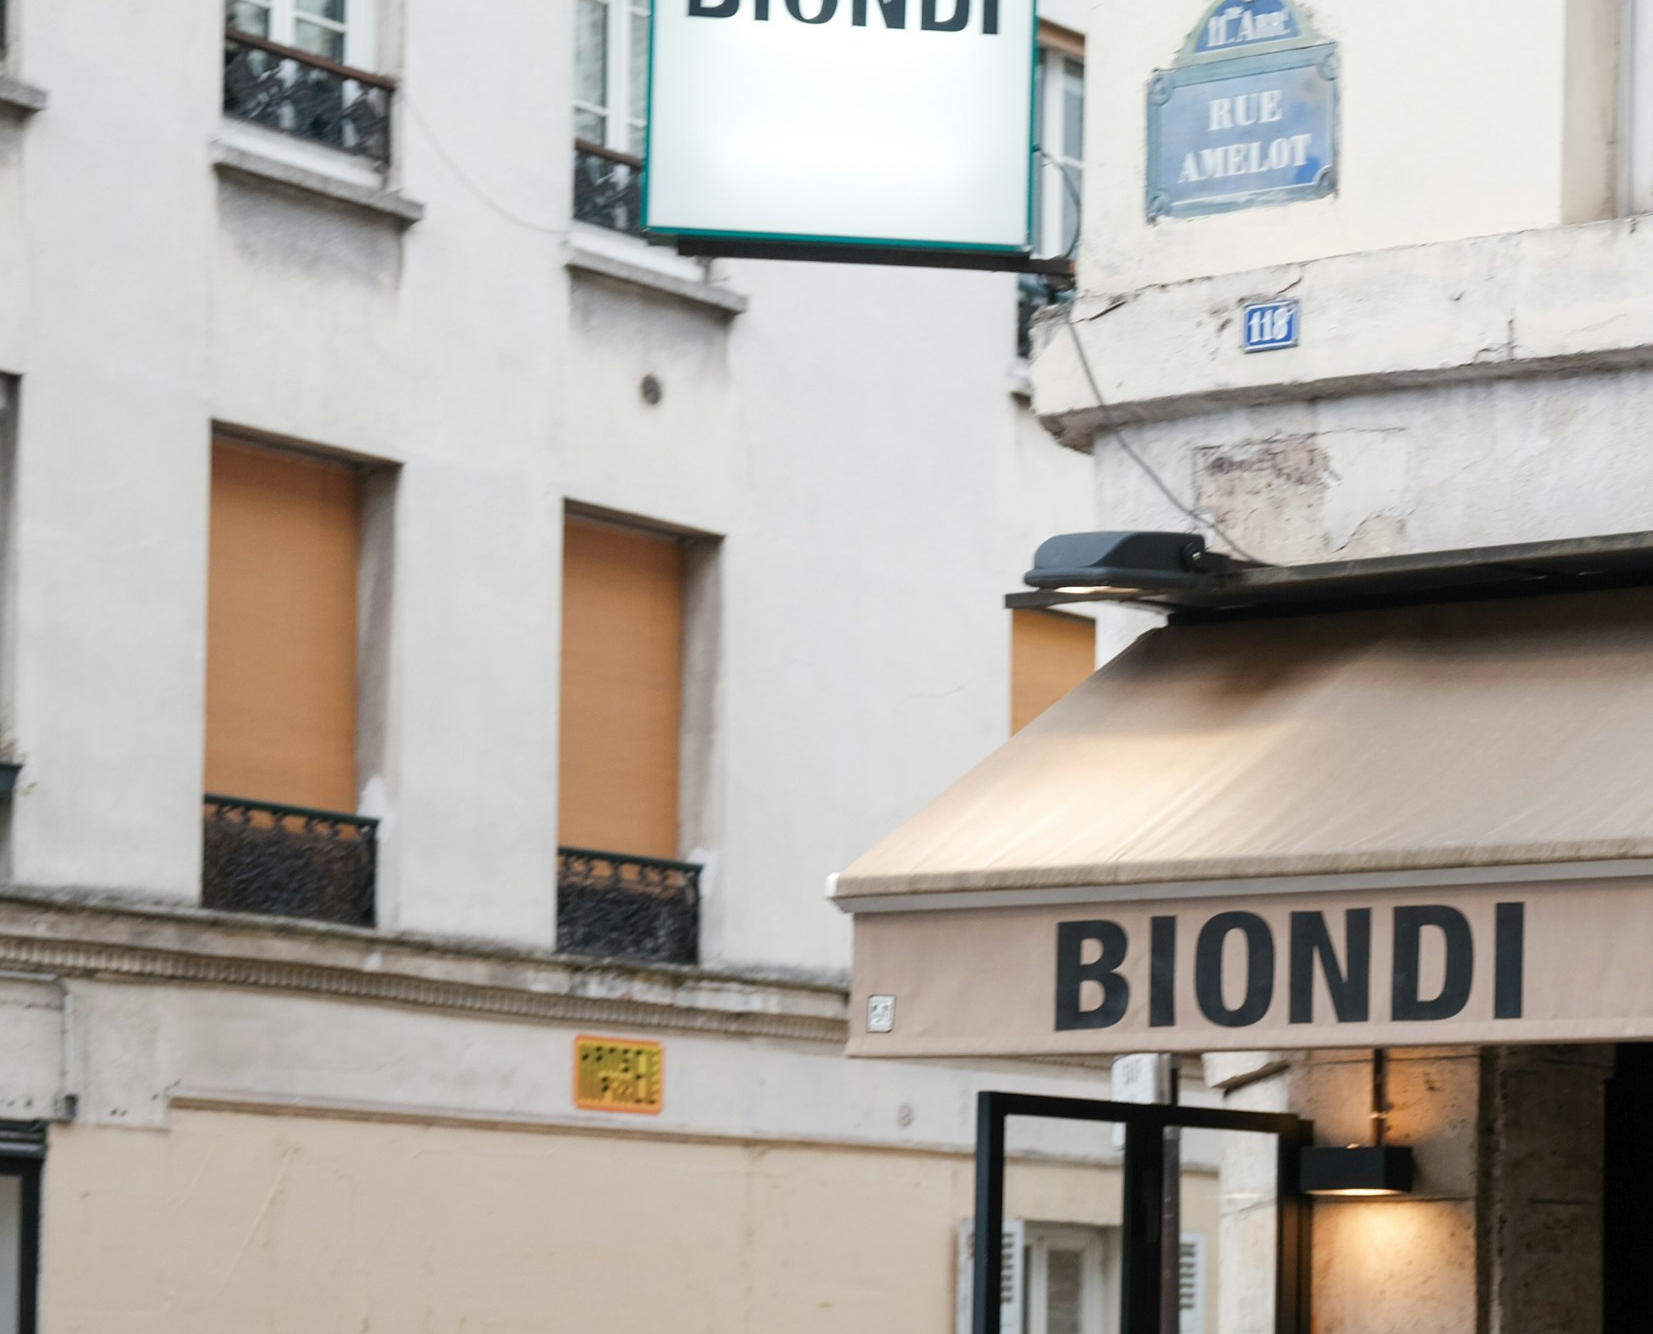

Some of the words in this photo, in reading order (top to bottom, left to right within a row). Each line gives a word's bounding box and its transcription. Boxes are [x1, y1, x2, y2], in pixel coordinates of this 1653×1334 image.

[1207, 89, 1283, 132] RUE
[1177, 133, 1313, 184] AMELOT
[1247, 305, 1289, 343] 118
[1054, 901, 1526, 1032] BIONDI
